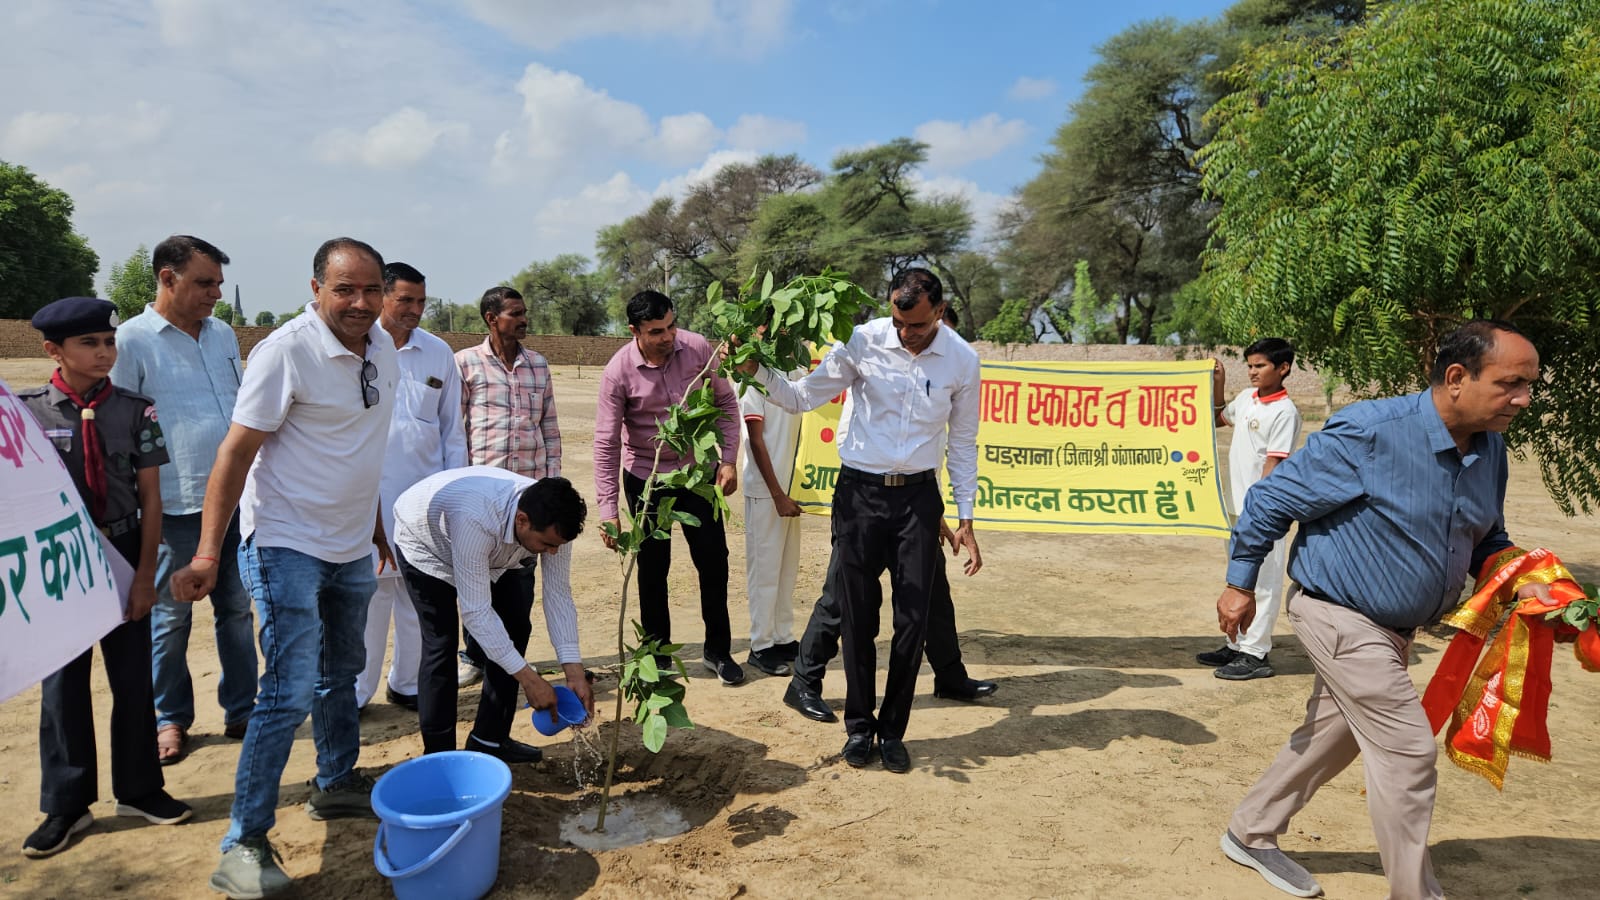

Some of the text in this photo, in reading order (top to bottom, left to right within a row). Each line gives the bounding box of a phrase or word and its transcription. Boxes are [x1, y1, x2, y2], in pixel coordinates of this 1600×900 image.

[979, 380, 1198, 433] ारत स्काउट व गाइड
[945, 476, 1062, 513] भिनन्दन
[1068, 488, 1148, 516] करता
